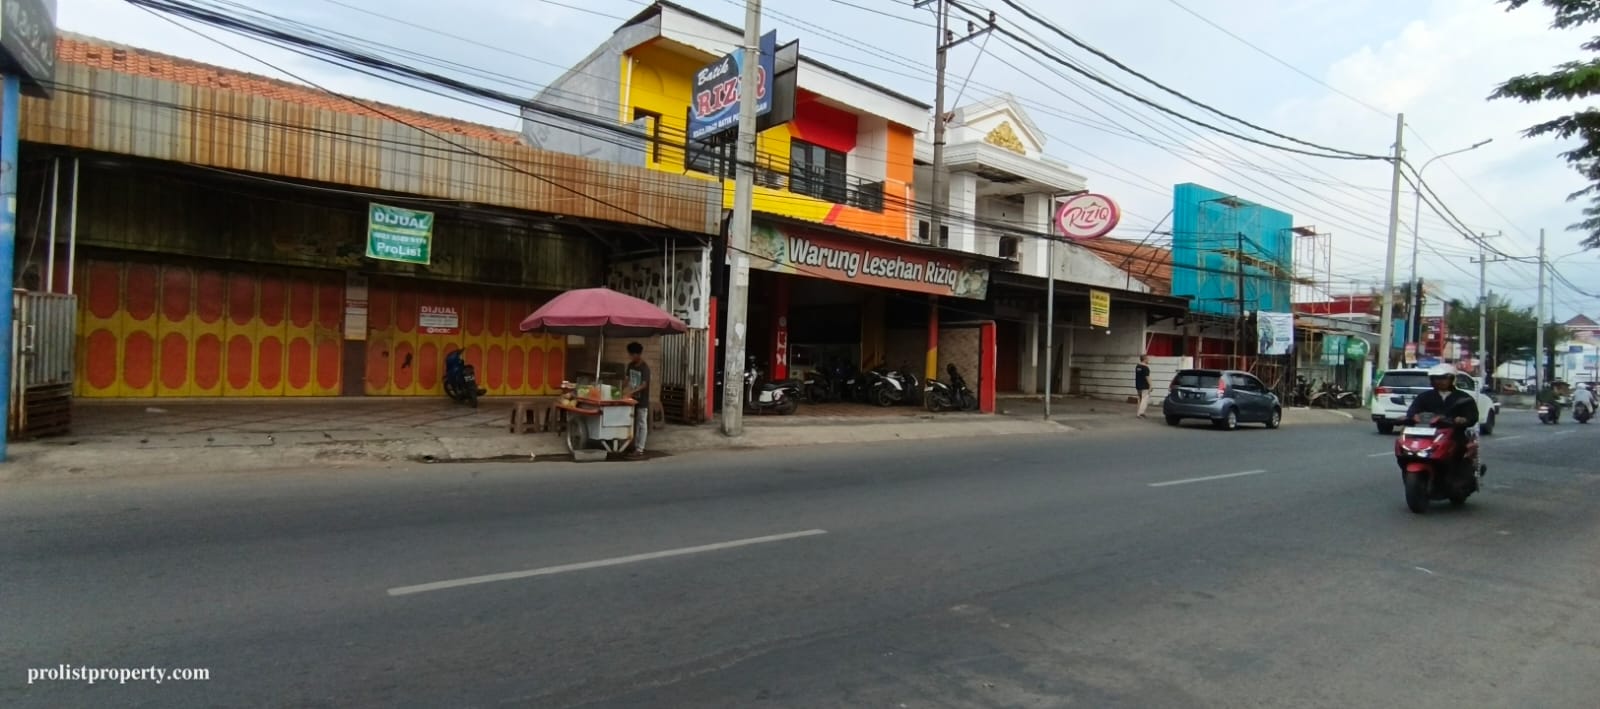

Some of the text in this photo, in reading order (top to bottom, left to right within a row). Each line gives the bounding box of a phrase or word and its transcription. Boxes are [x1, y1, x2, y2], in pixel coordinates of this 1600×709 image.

[698, 58, 730, 86] Batik
[696, 65, 767, 118] RIZQ
[374, 211, 428, 229] DIJUAL
[376, 241, 422, 257] ProList
[789, 236, 959, 290] Warung Lesehan Riziq
[421, 305, 457, 314] DIJUAL
